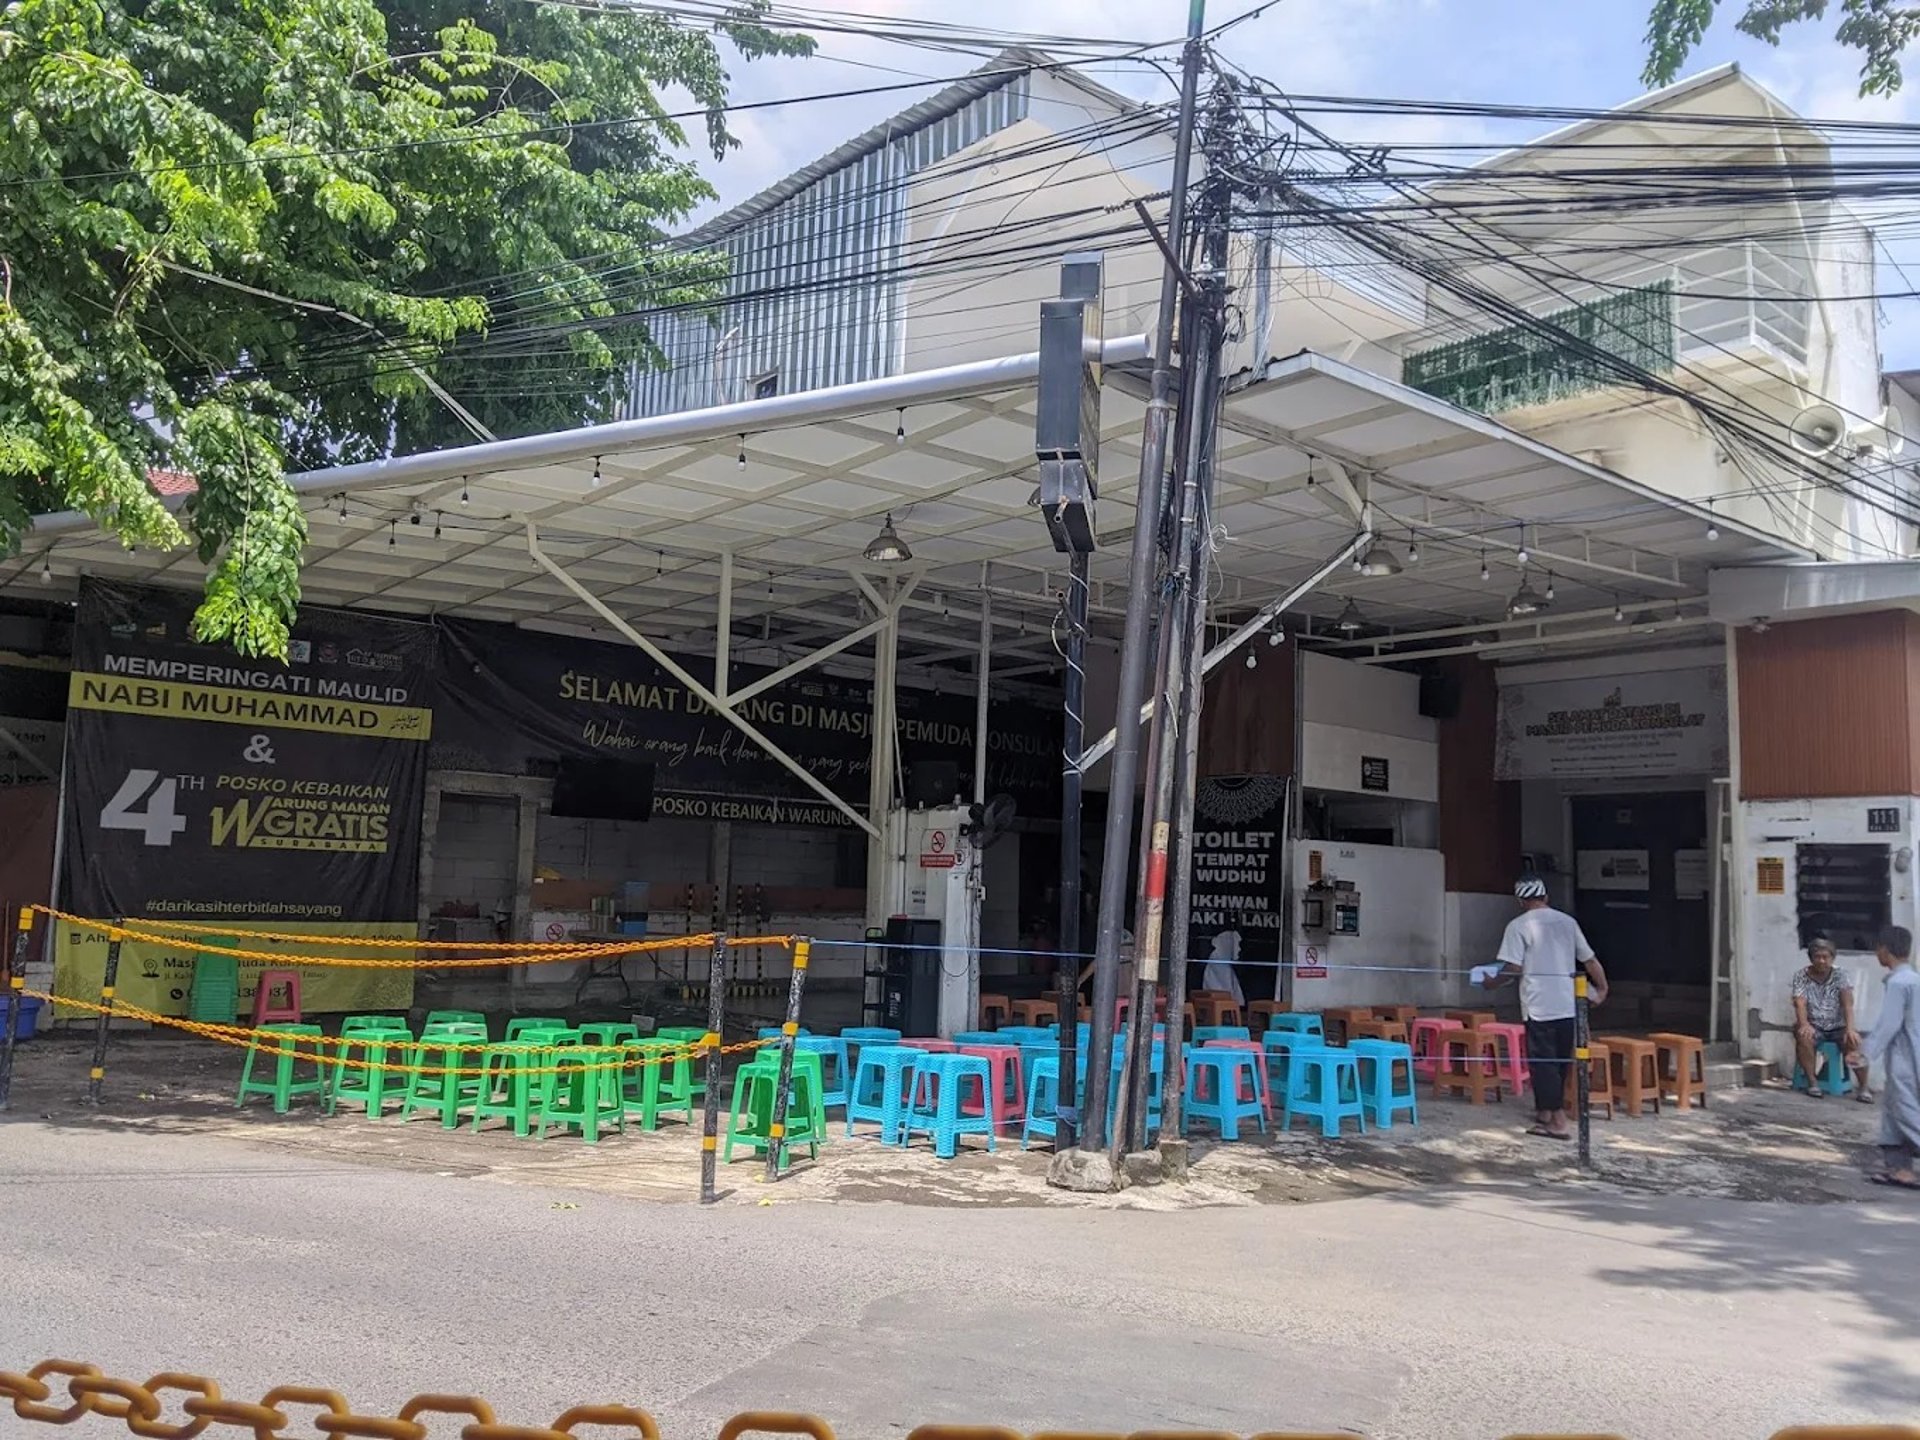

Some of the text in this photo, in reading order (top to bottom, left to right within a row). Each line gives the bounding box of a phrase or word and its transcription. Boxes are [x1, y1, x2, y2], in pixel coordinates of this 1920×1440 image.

[104, 653, 310, 694] MEMPERINGATI
[317, 678, 408, 704] MAULID
[82, 679, 169, 709] NABI
[181, 690, 379, 730] MUHAMMAD
[558, 671, 680, 712] SELAMAT
[791, 703, 814, 728] DI
[818, 706, 874, 739] MASJI
[896, 718, 973, 747] PEMUDA
[243, 734, 276, 764] &
[582, 718, 638, 748] Wahai
[692, 726, 734, 766] baik
[216, 775, 390, 799] POSKO KEBAIKAN
[331, 800, 391, 815] MAKAN
[653, 796, 707, 817] POSKO
[711, 800, 786, 823] KEBAIKAN
[788, 806, 851, 827] WARUNG
[1872, 809, 1896, 825] 111
[259, 838, 377, 851] SURABAYA
[1192, 831, 1275, 849] TOILET
[1193, 852, 1270, 868] TEMPAT
[1195, 869, 1267, 884] WUDHU
[146, 899, 343, 917] #darikasihterbitlahsayang
[1191, 893, 1269, 911] IKHWAN
[1190, 911, 1225, 926] AKI
[1241, 913, 1280, 929] LAKI
